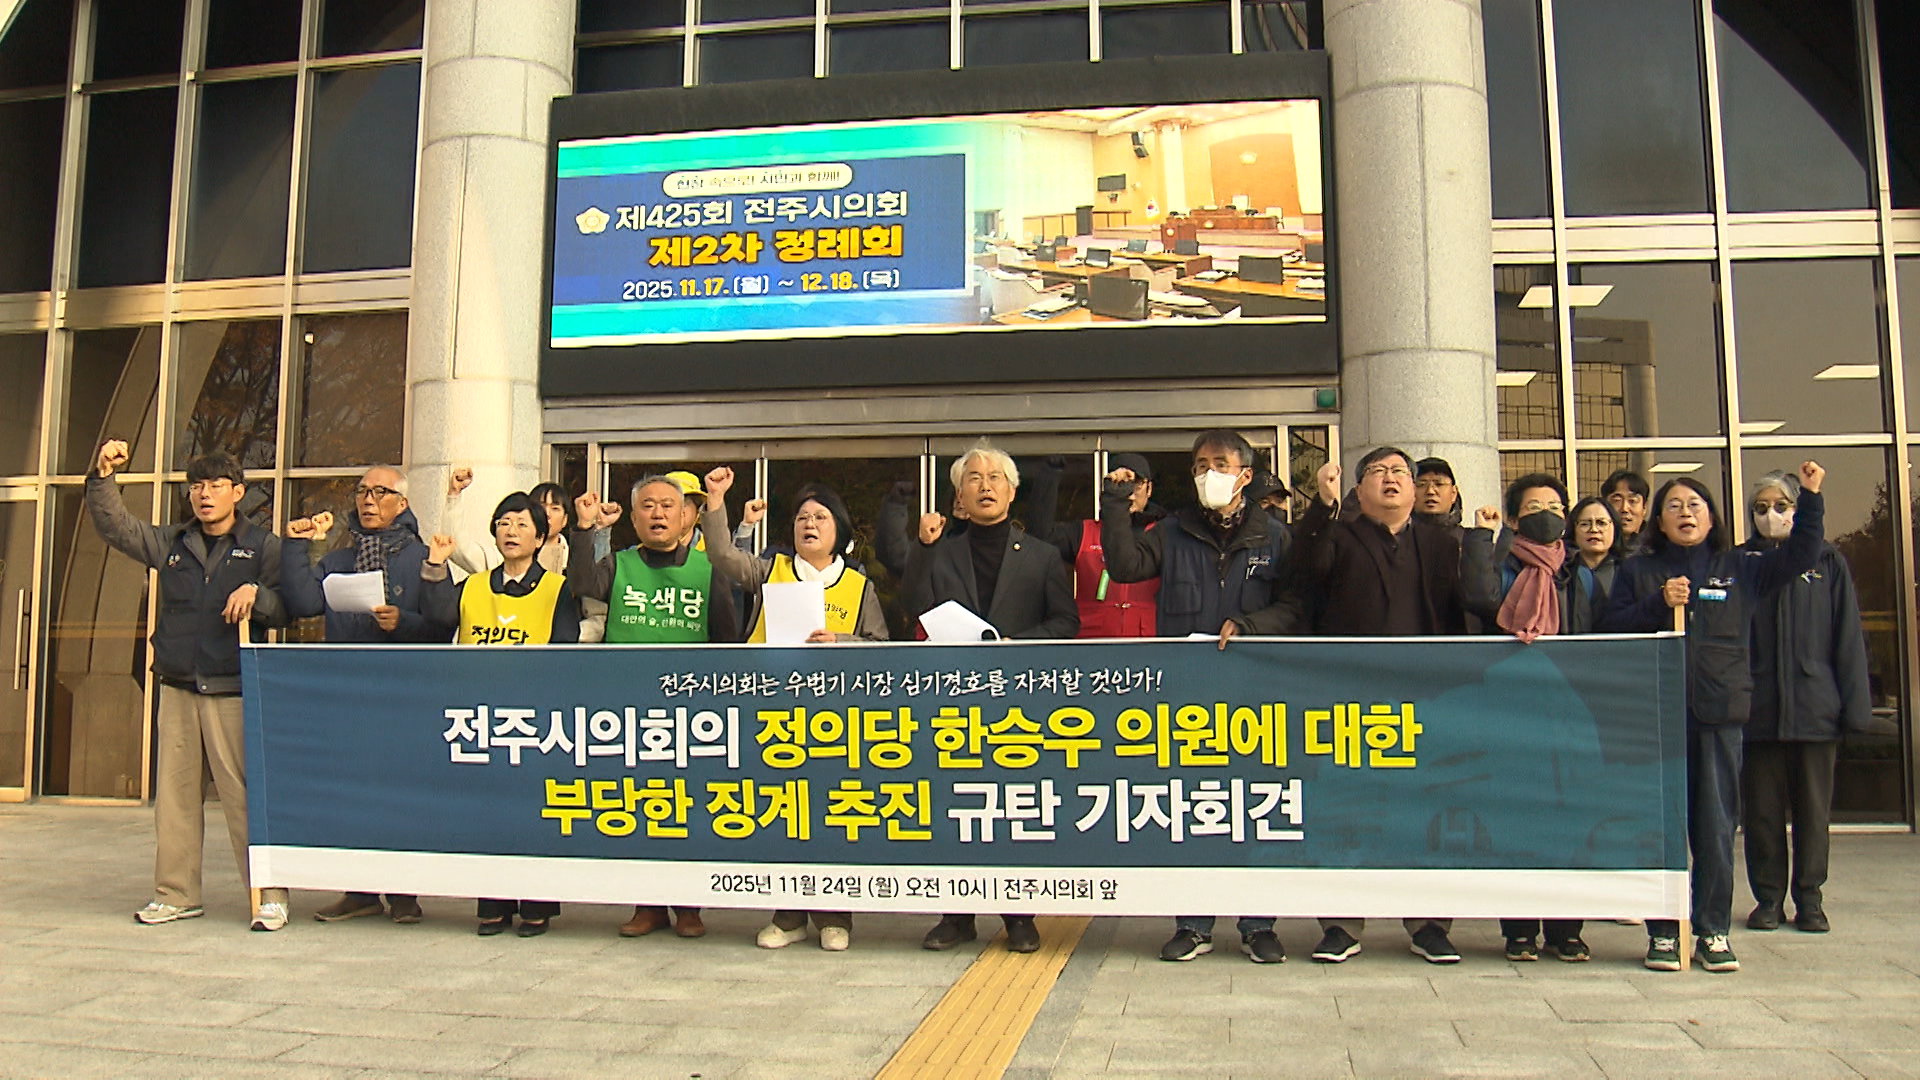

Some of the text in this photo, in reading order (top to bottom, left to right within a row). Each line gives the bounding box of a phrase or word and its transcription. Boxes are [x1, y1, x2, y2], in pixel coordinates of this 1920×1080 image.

[615, 190, 908, 231] 제425회 전주시의회
[648, 225, 904, 267] 제2차 정례회
[622, 584, 704, 618] 녹색당
[658, 667, 1163, 698] 전주시의회는 우범기 시장 심기경호를 자처할 것인가!
[443, 703, 1423, 769] 전주시의회의 정의당 한승우 의원에 대한
[541, 777, 1304, 842] 부당한 징계 추진 규탄 기자회견
[710, 873, 771, 895] 2025년
[778, 875, 817, 896] 11월
[822, 876, 862, 898] 24일
[868, 877, 899, 898] (월)
[905, 877, 940, 899] 오전
[947, 878, 987, 900] 10시
[1003, 879, 1094, 900] 전주시의회
[1099, 879, 1119, 901] 앞
